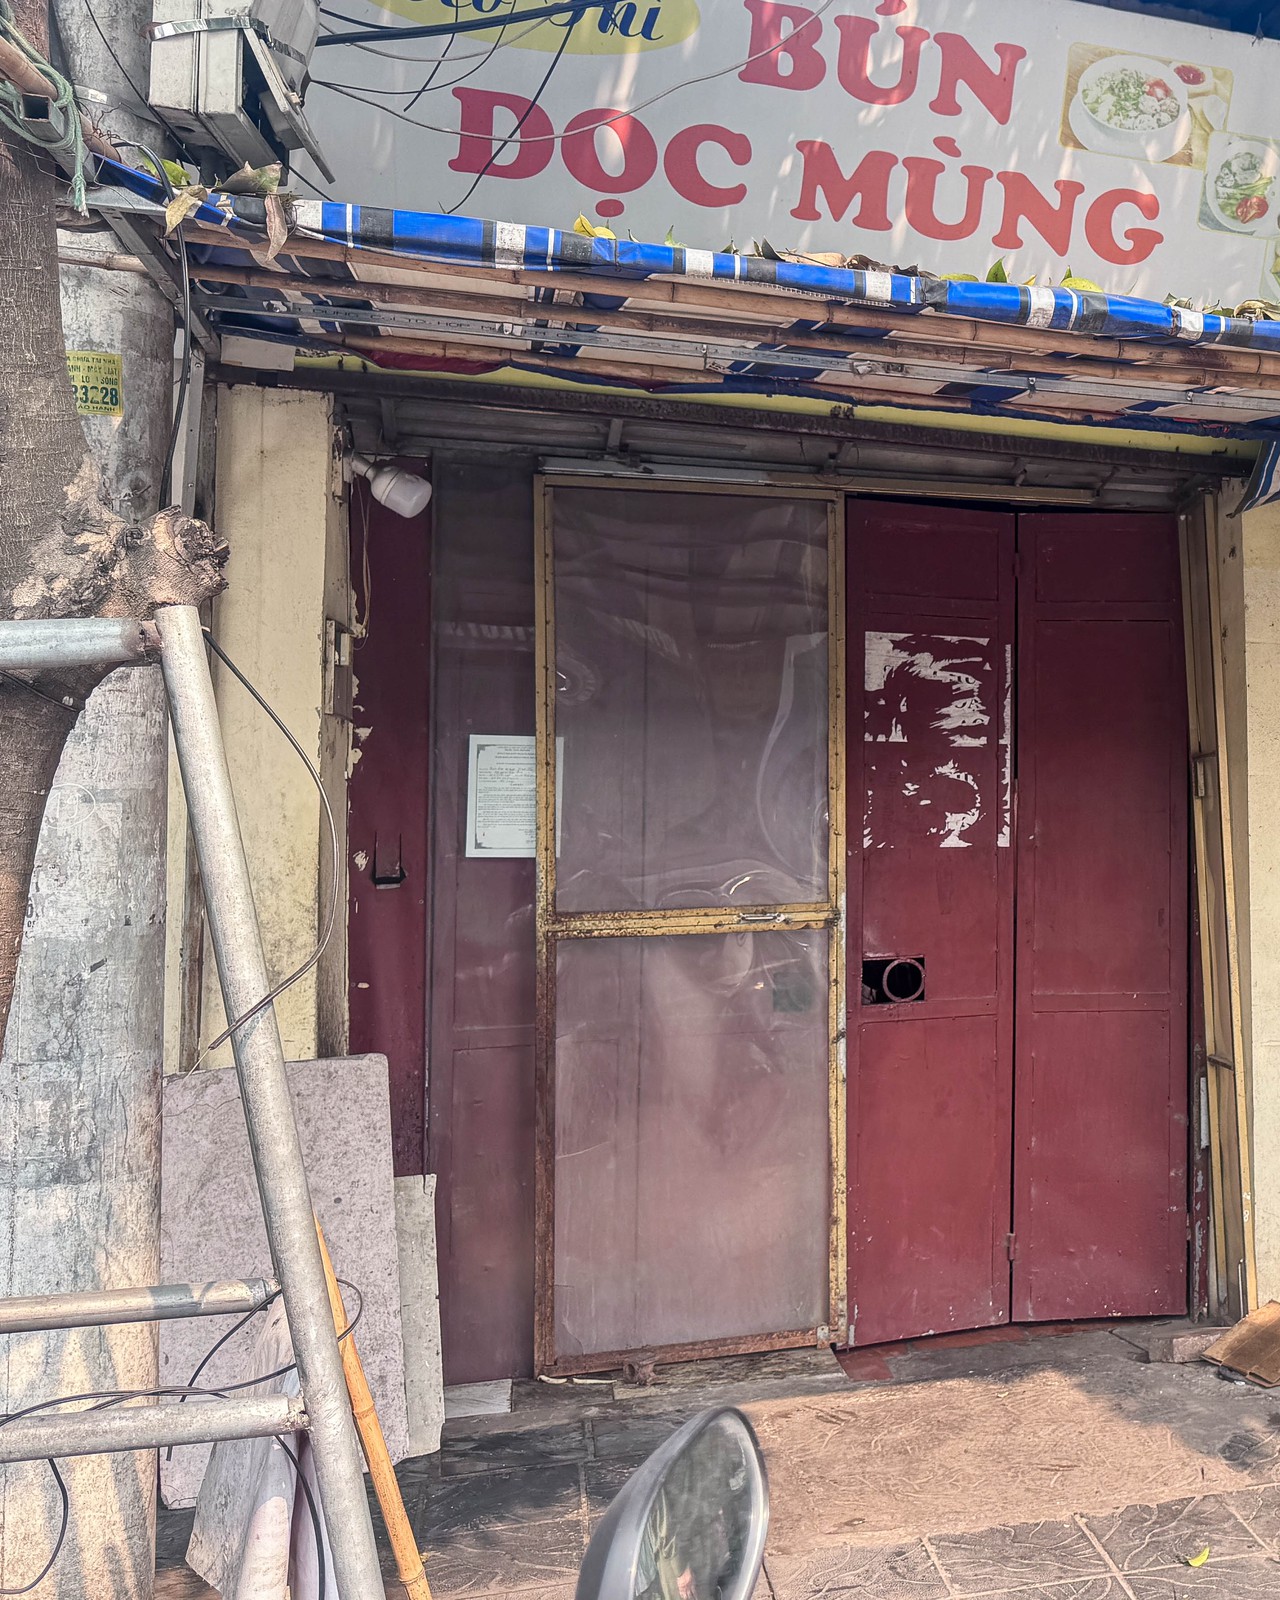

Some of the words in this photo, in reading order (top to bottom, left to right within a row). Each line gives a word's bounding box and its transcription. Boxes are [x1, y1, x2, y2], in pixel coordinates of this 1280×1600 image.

[738, 0, 1026, 125] BÚN
[448, 87, 753, 218] DỌC
[790, 136, 1164, 265] MÙNG
